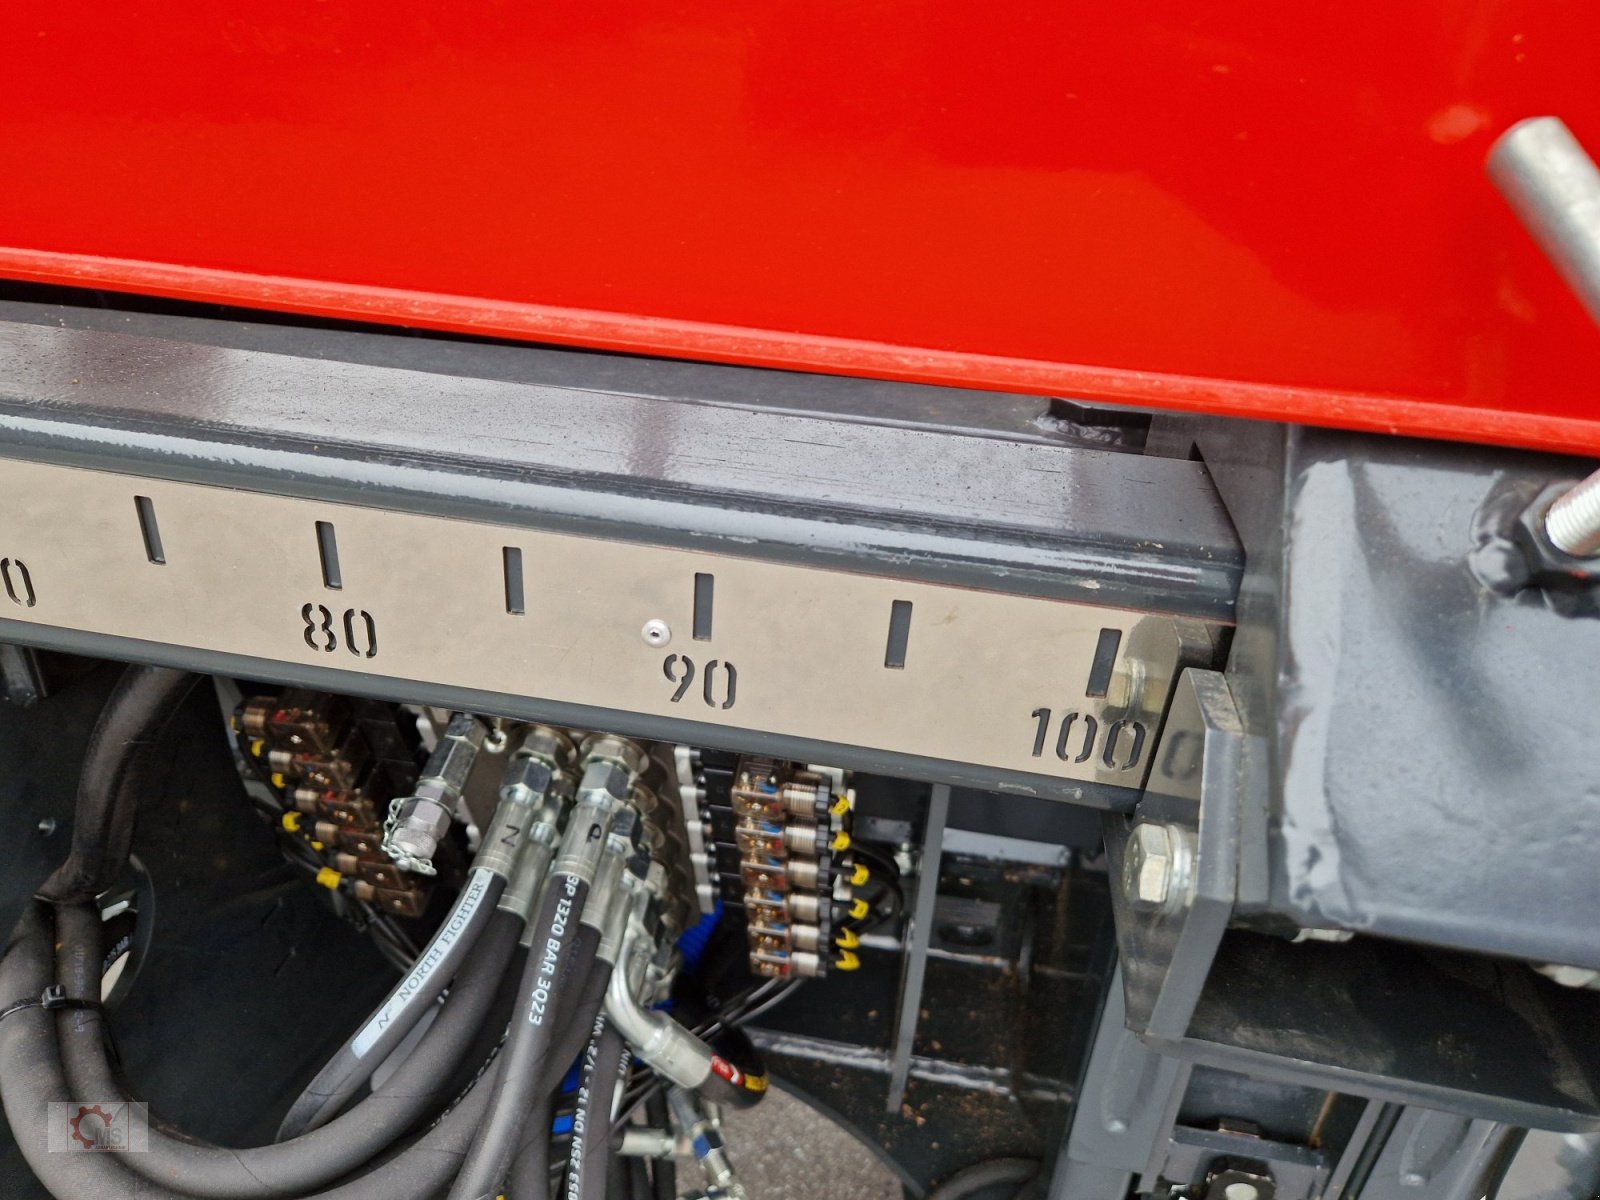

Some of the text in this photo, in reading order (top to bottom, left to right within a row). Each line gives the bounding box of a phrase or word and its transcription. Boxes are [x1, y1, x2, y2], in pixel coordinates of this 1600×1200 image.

[301, 602, 377, 658] 80
[662, 653, 737, 709] 90
[1032, 707, 1146, 771] 100
[585, 823, 602, 844] P
[550, 897, 573, 938] 1320
[397, 947, 443, 1002] NORTH
[441, 881, 485, 946] FIGHTER
[541, 937, 562, 976] BAR
[528, 976, 552, 1026] 3Q23
[577, 1086, 590, 1105] 12
[573, 1107, 587, 1134] DN
[569, 1135, 584, 1169] 2SN
